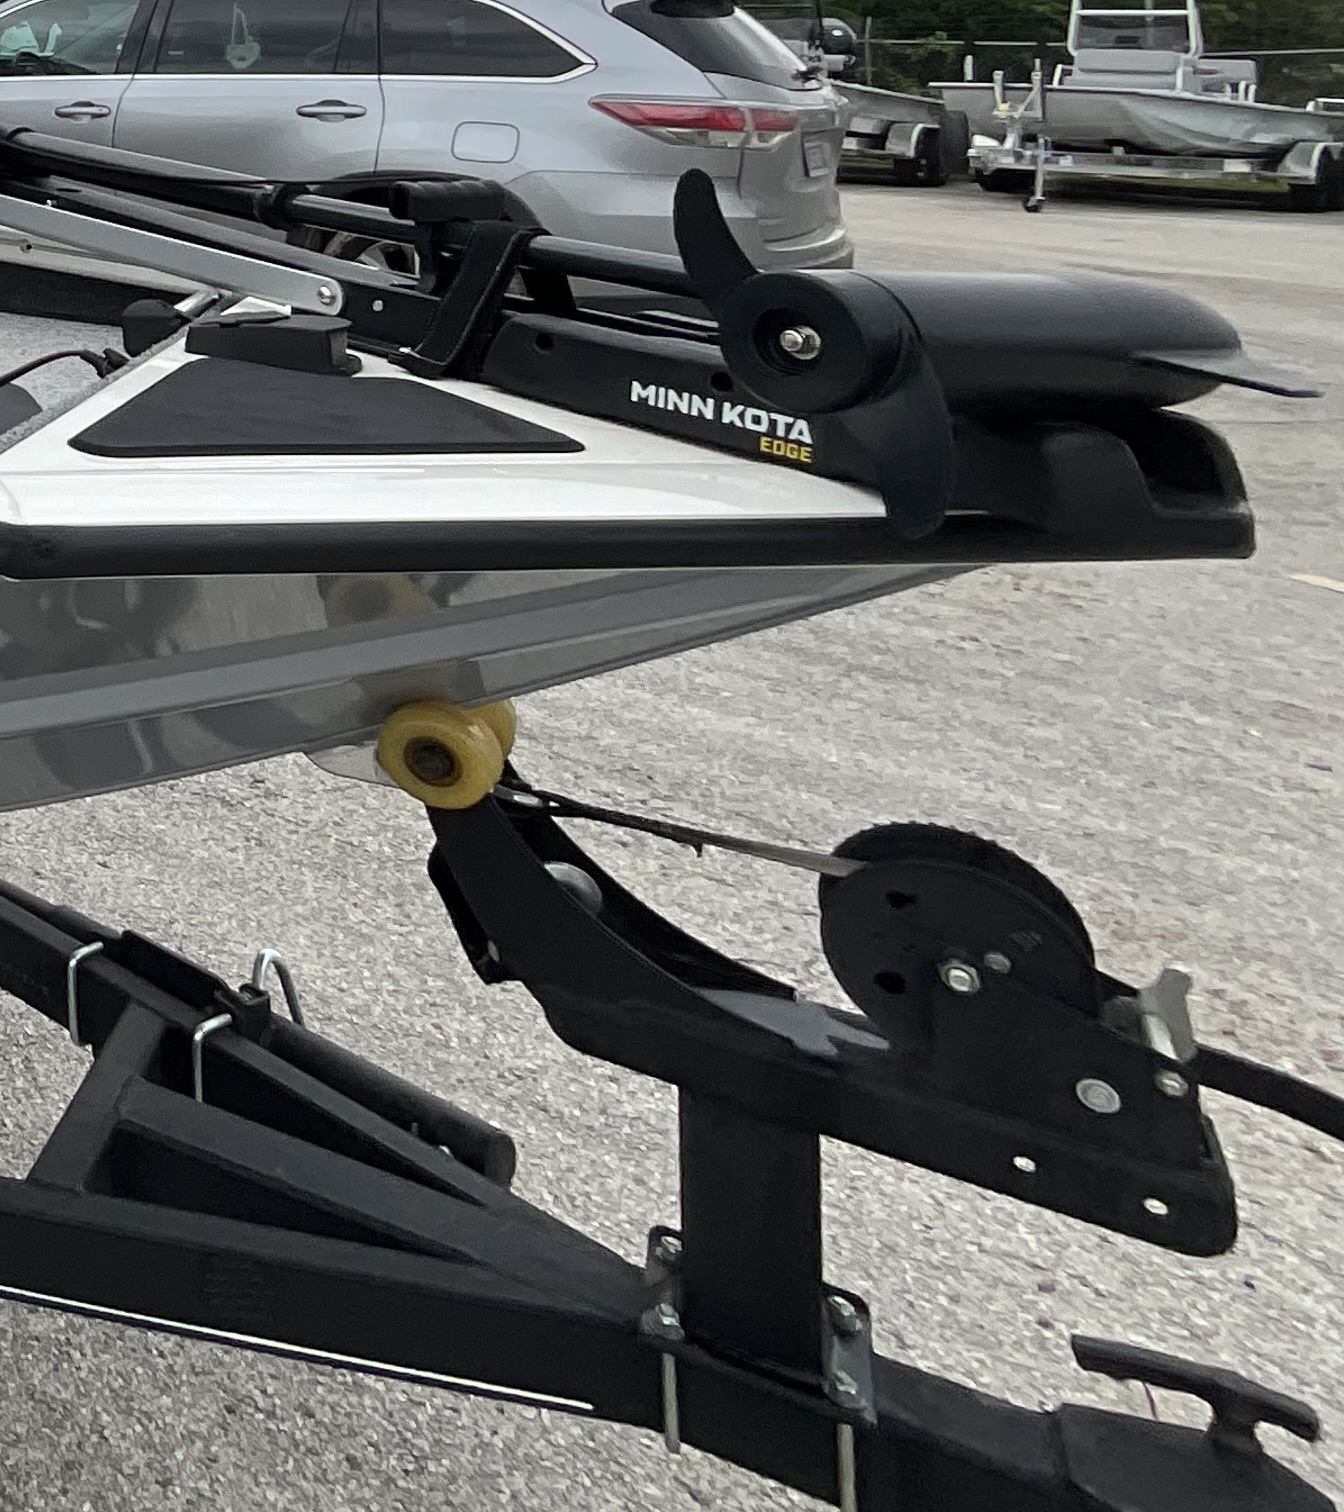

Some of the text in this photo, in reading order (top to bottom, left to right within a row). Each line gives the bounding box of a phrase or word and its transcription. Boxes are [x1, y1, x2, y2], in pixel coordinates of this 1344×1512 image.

[630, 380, 813, 444] MINN KOTA
[760, 436, 813, 463] EDGE
